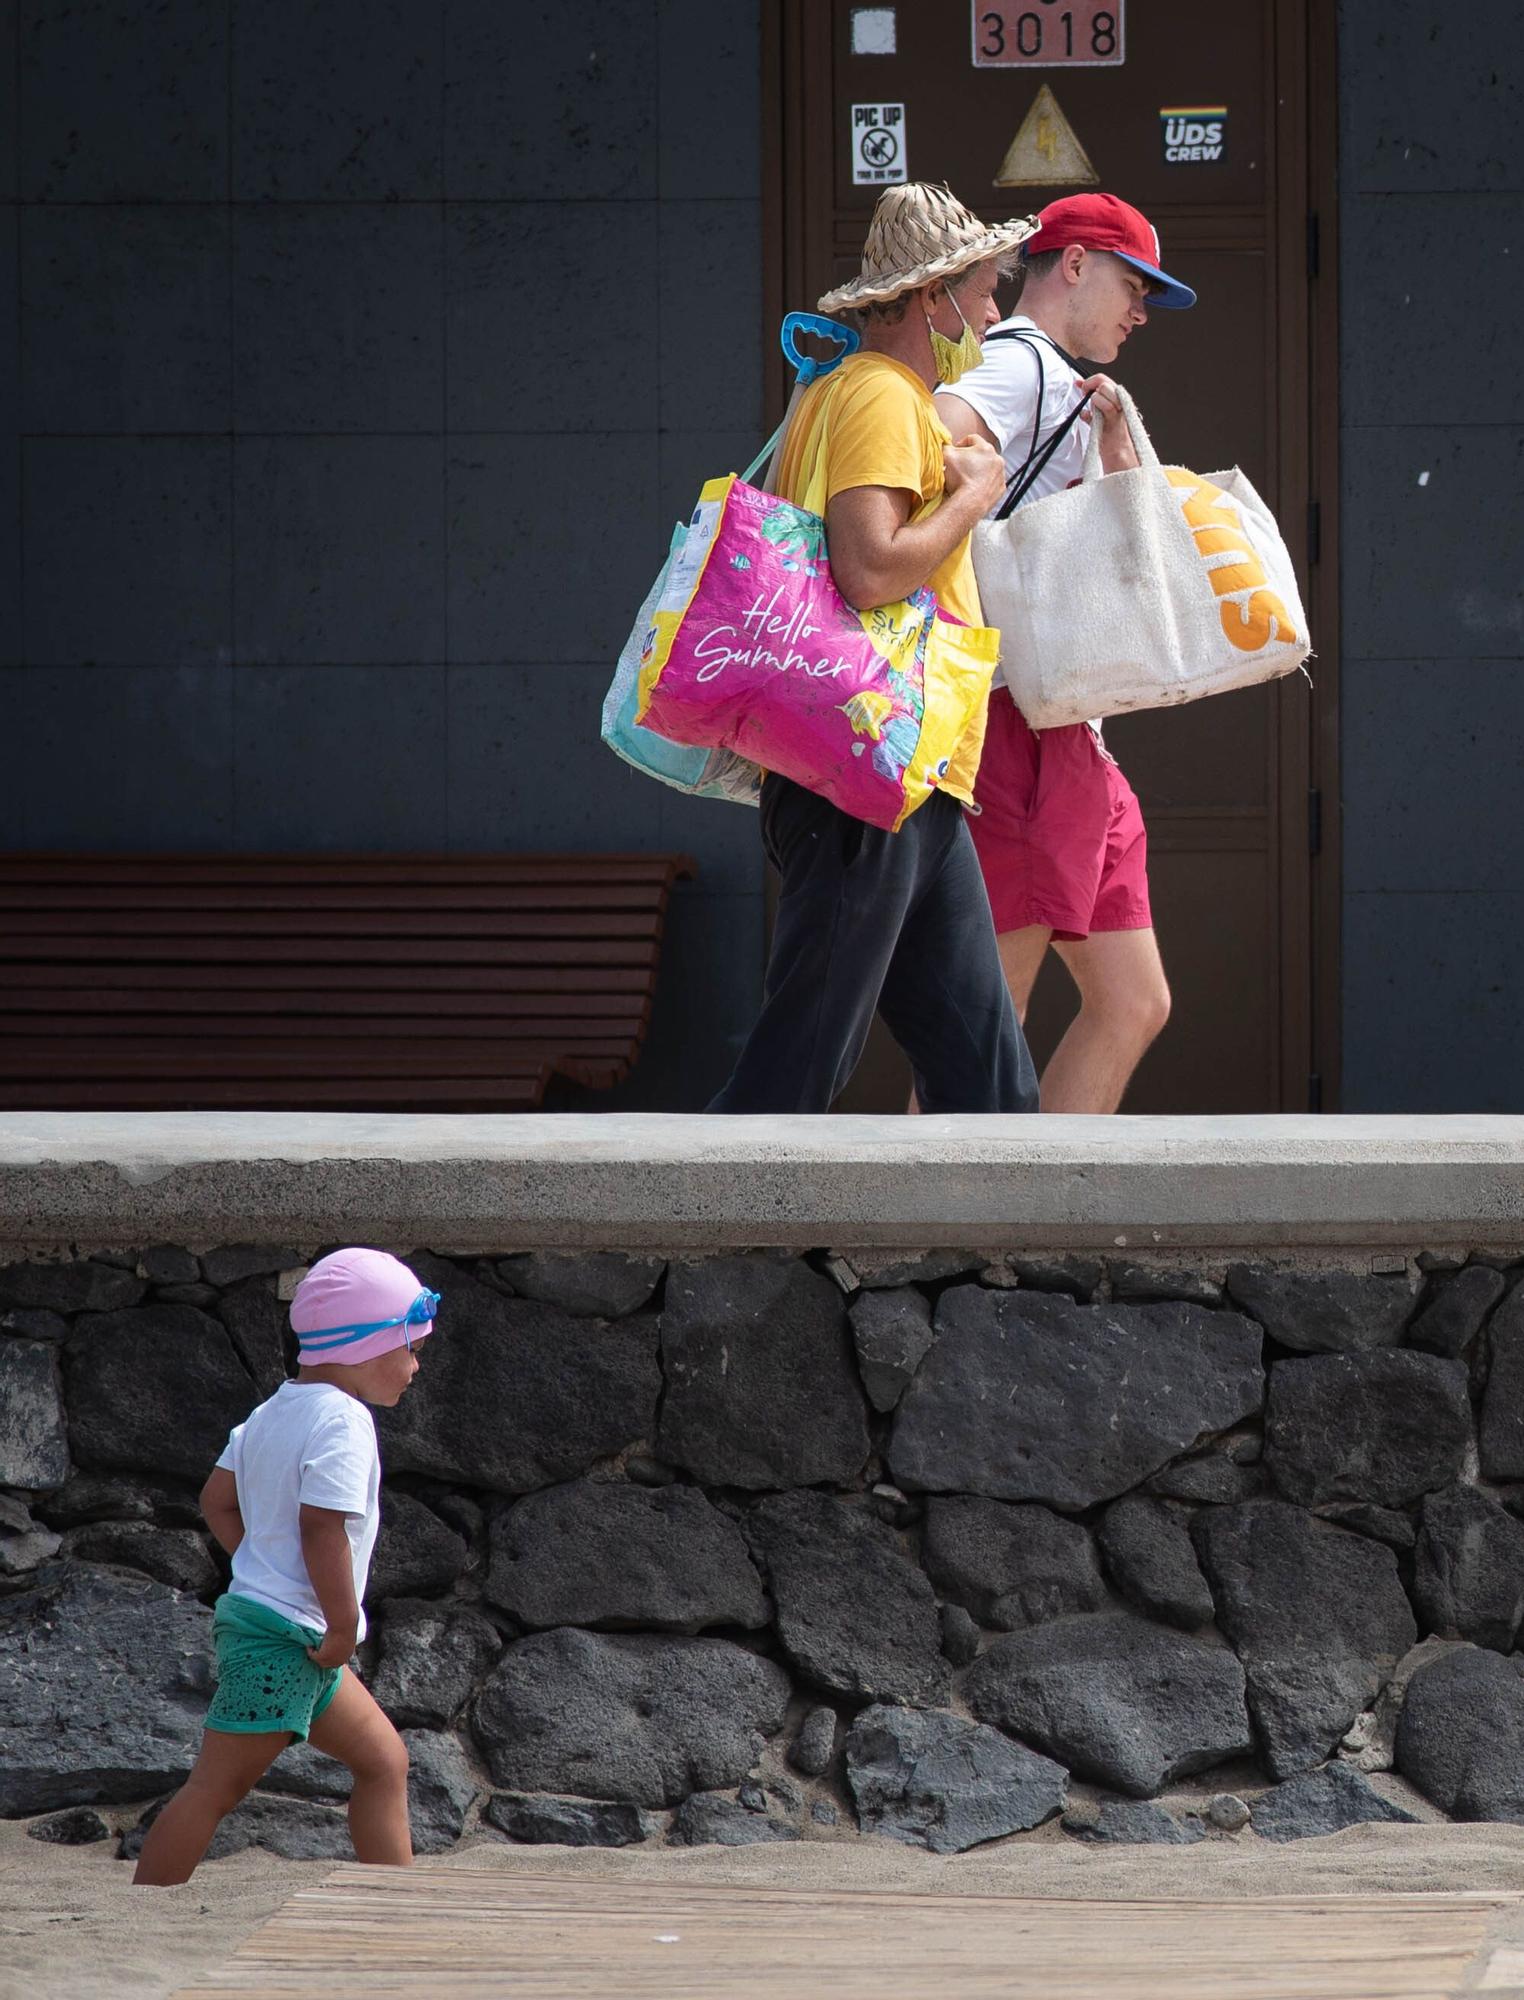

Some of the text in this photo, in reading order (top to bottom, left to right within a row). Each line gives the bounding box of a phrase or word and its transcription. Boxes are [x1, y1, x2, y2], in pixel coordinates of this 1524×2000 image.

[981, 11, 1116, 57] 3018
[855, 106, 901, 127] PIC UP
[1165, 118, 1223, 146] ÜDS
[1165, 145, 1223, 162] CREW
[1164, 469, 1297, 652] SUN
[742, 585, 821, 644] Hello
[694, 625, 852, 682] Summer
